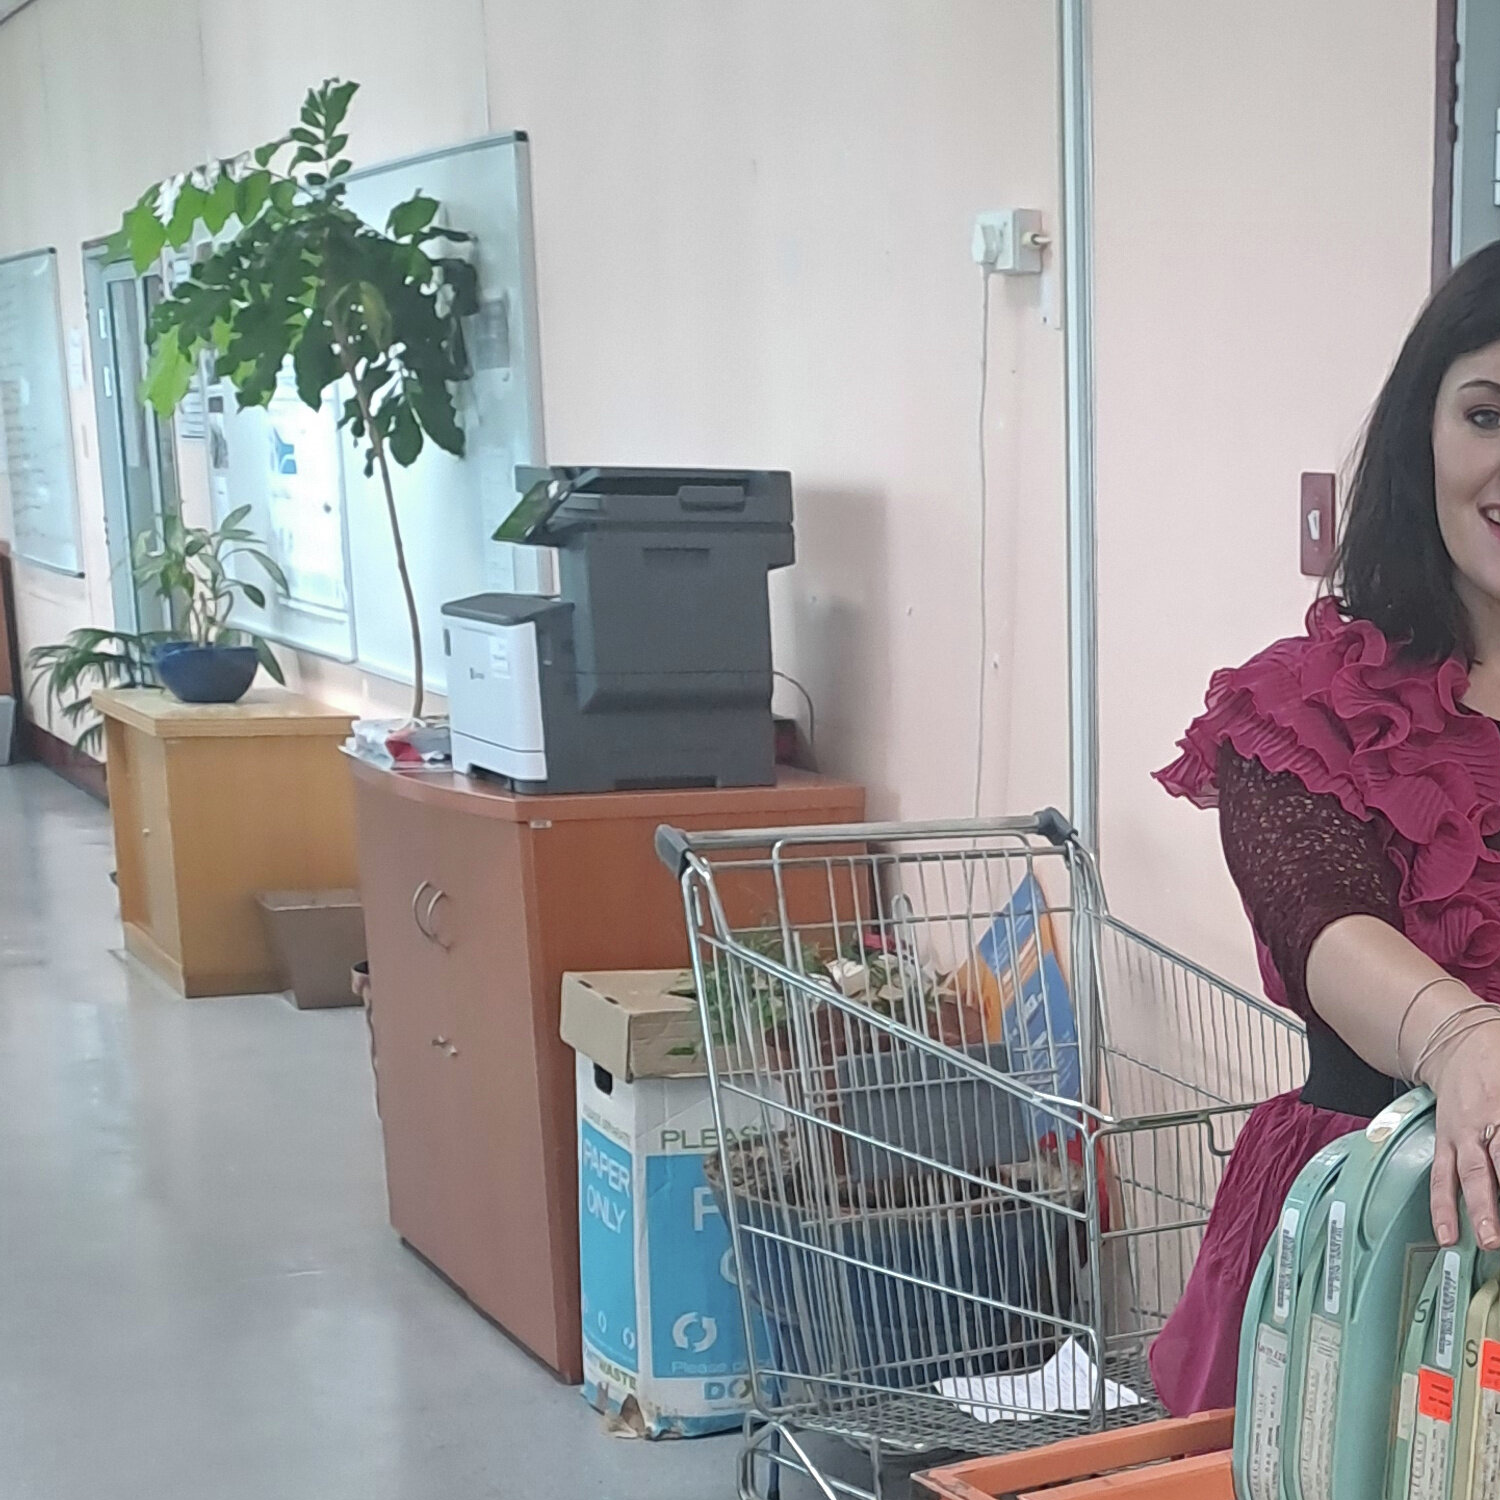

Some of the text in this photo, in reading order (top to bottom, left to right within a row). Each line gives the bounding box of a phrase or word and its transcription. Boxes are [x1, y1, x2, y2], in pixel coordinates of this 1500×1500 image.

[583, 1138, 630, 1198] PAPER
[587, 1184, 626, 1234] ONLY
[1414, 1299, 1430, 1323] S
[1465, 1339, 1478, 1368] S
